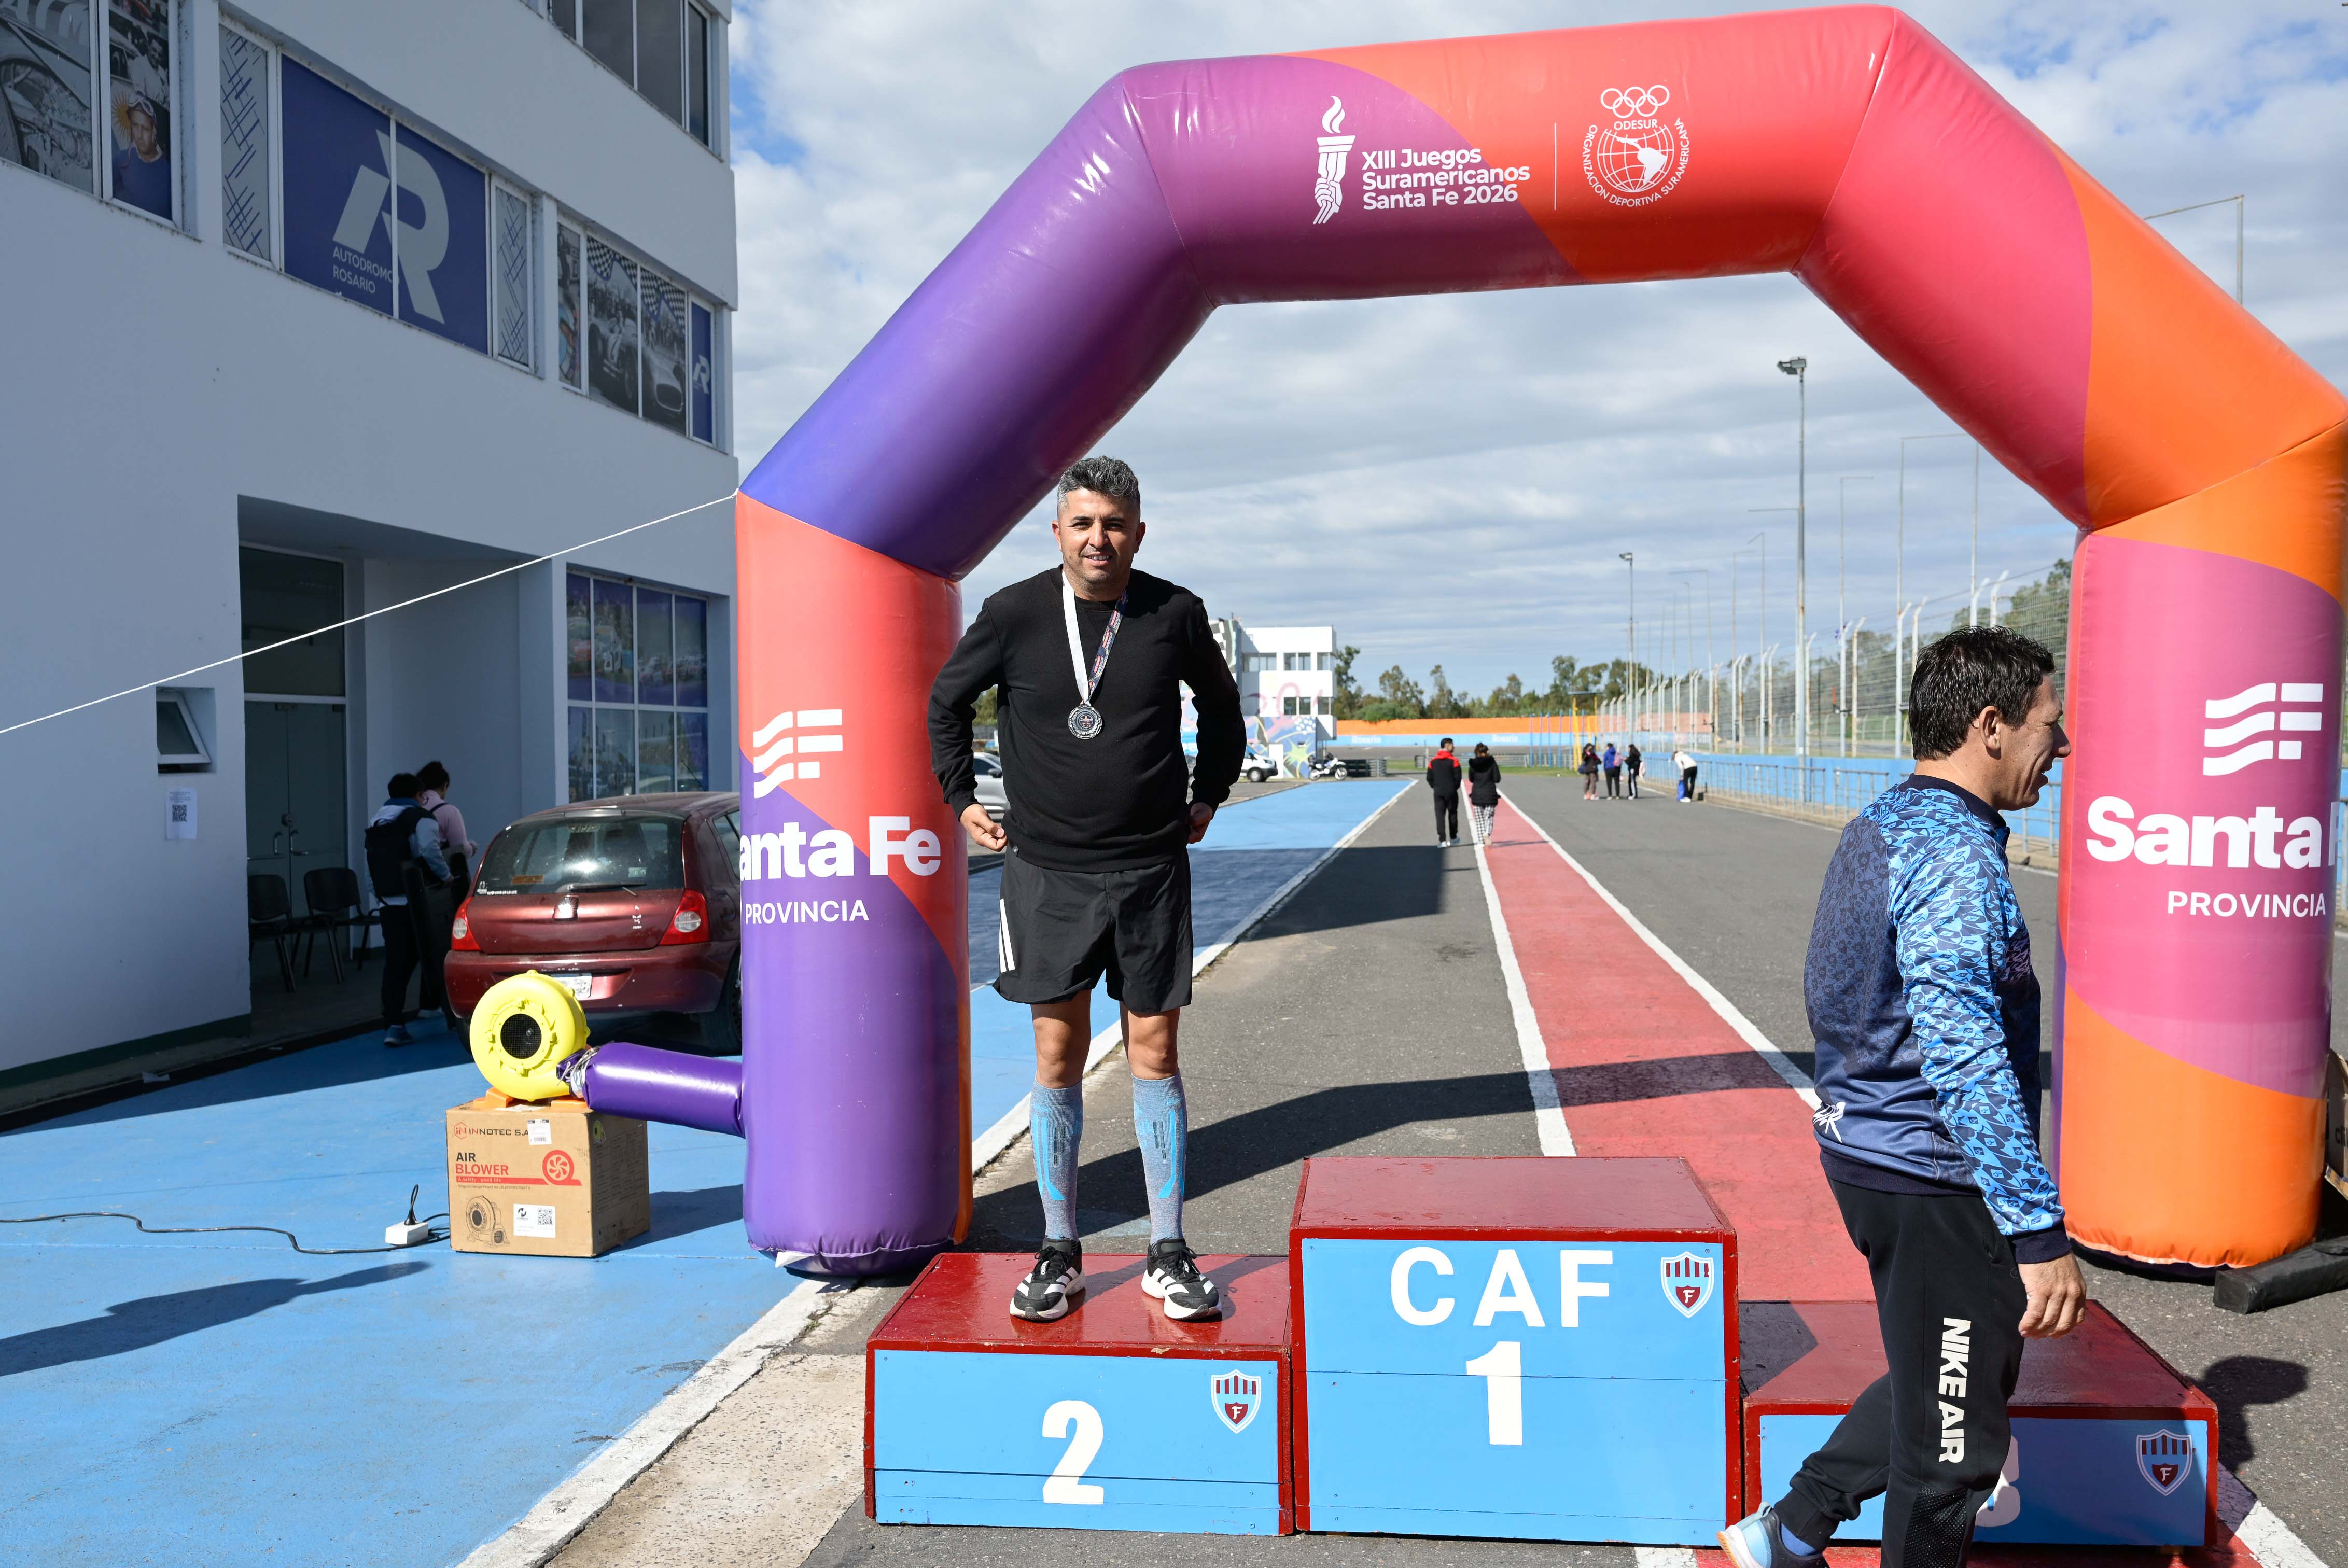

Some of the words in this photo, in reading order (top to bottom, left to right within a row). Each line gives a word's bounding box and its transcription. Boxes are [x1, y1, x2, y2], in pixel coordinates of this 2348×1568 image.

[1614, 119, 1658, 130] ODESUR
[1361, 151, 1396, 170] XIII
[1400, 148, 1482, 171] Juegos
[1582, 124, 1610, 199] ORGANIZACION
[1609, 192, 1662, 207] DEPORTIVA
[1661, 118, 1689, 195] SURAMERICANA
[1362, 163, 1530, 191] Suramericanos
[1363, 191, 1427, 211] Santa
[1432, 188, 1458, 206] Fe
[1463, 184, 1518, 204] 2026
[333, 265, 375, 293] ROSARIO
[2086, 796, 2322, 869] Santa
[739, 822, 854, 881] anta
[869, 816, 941, 877] Fe
[745, 900, 869, 925] PROVINCIA
[2167, 891, 2326, 919] PROVINCIA
[455, 1164, 509, 1175] BLOWER
[456, 1152, 476, 1162] AIR
[1391, 1247, 1614, 1327] CAF
[1938, 1318, 1972, 1397] NIKE
[1466, 1341, 1523, 1445] 1
[1938, 1401, 1965, 1463] AIR
[1042, 1400, 1104, 1504] 2
